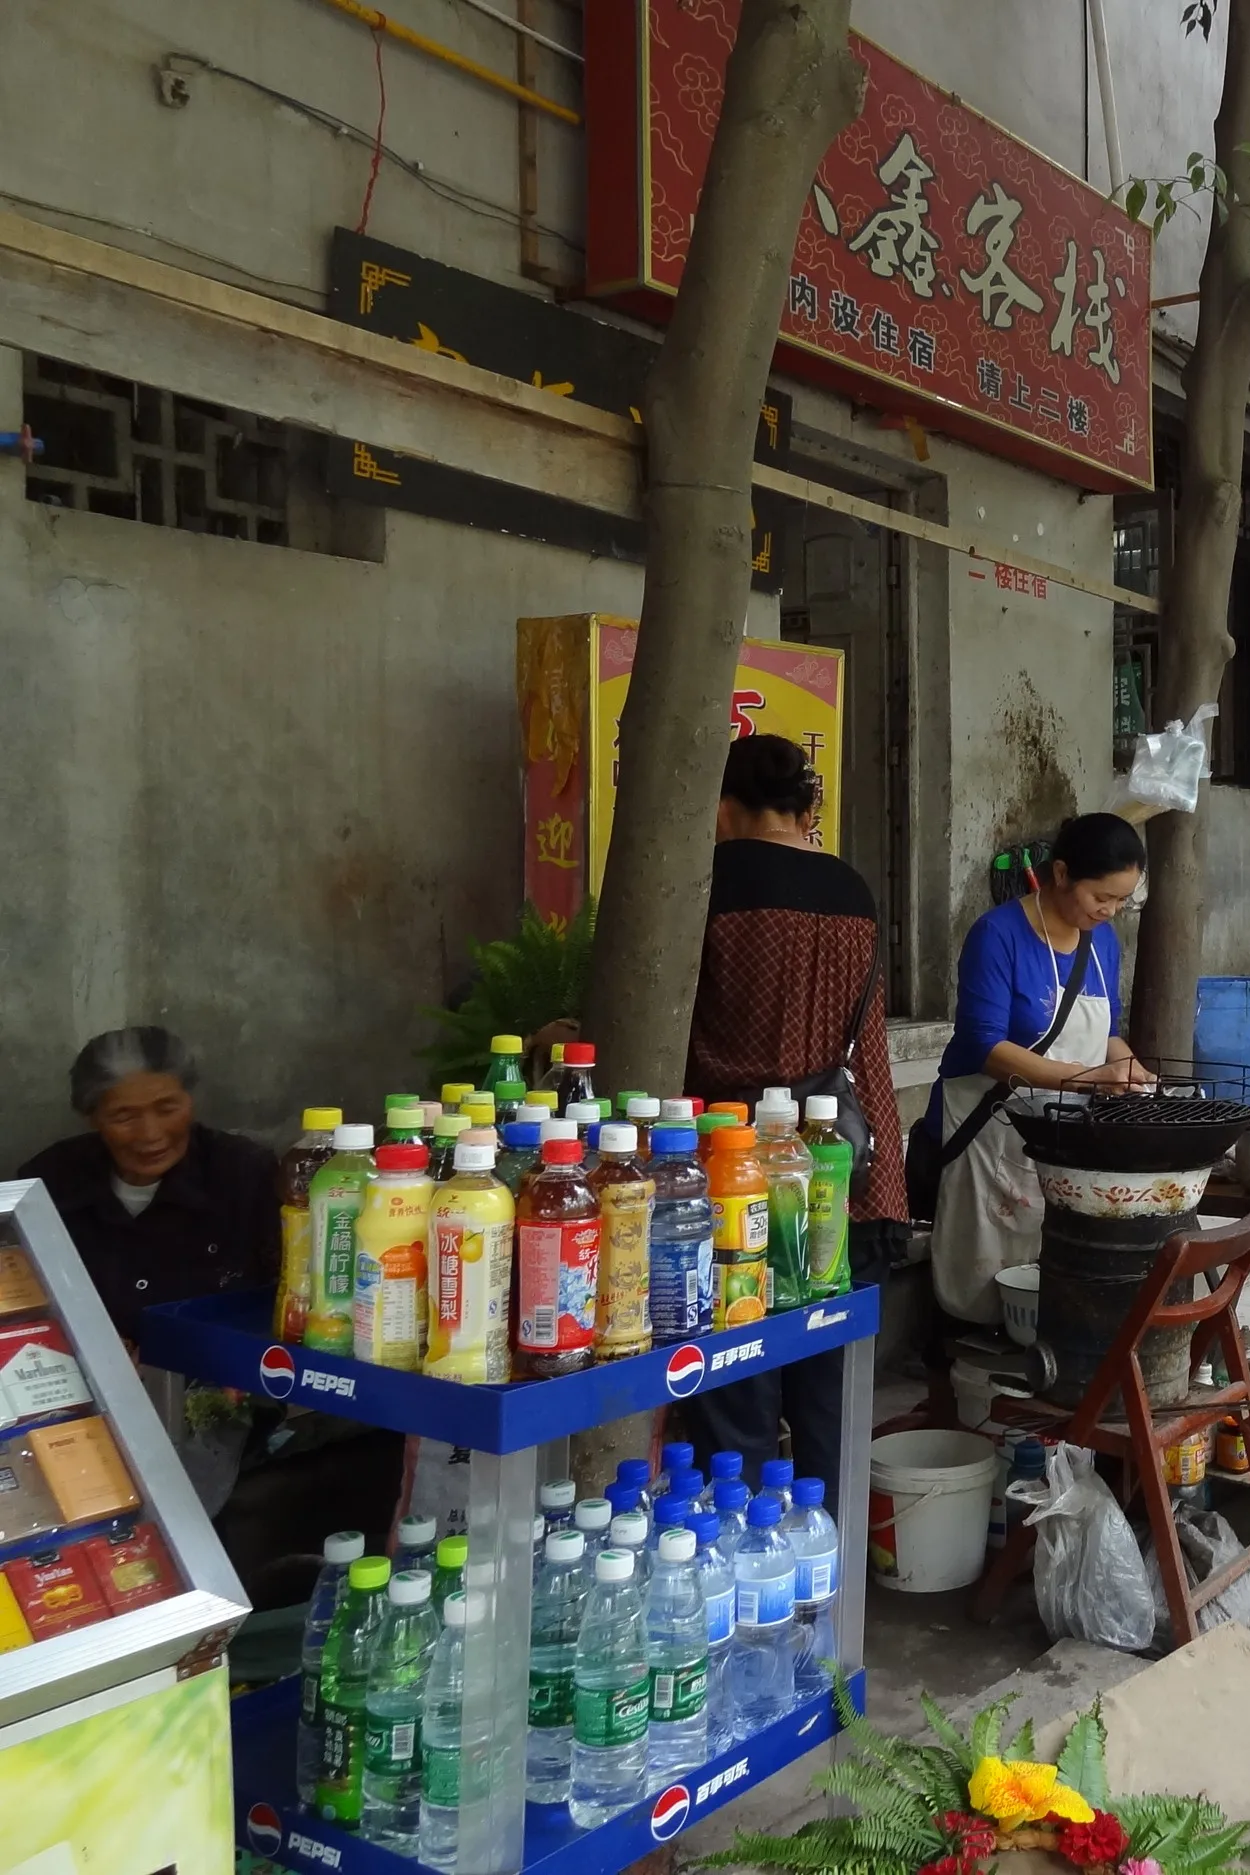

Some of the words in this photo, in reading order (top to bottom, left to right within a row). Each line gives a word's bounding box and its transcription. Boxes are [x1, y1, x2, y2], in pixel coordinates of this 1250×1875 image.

[814, 133, 1126, 384] 鑫客栈
[788, 273, 936, 373] 内设住宿
[977, 357, 1090, 438] 请上二楼
[328, 1210, 354, 1295] 金橘柠檬
[440, 1231, 460, 1321] 冰糖雪梨
[300, 1368, 356, 1398] PEPSI
[710, 1338, 763, 1372] 百事可乐
[695, 1756, 749, 1806] 百事可乐
[287, 1831, 342, 1869] PEPSI
